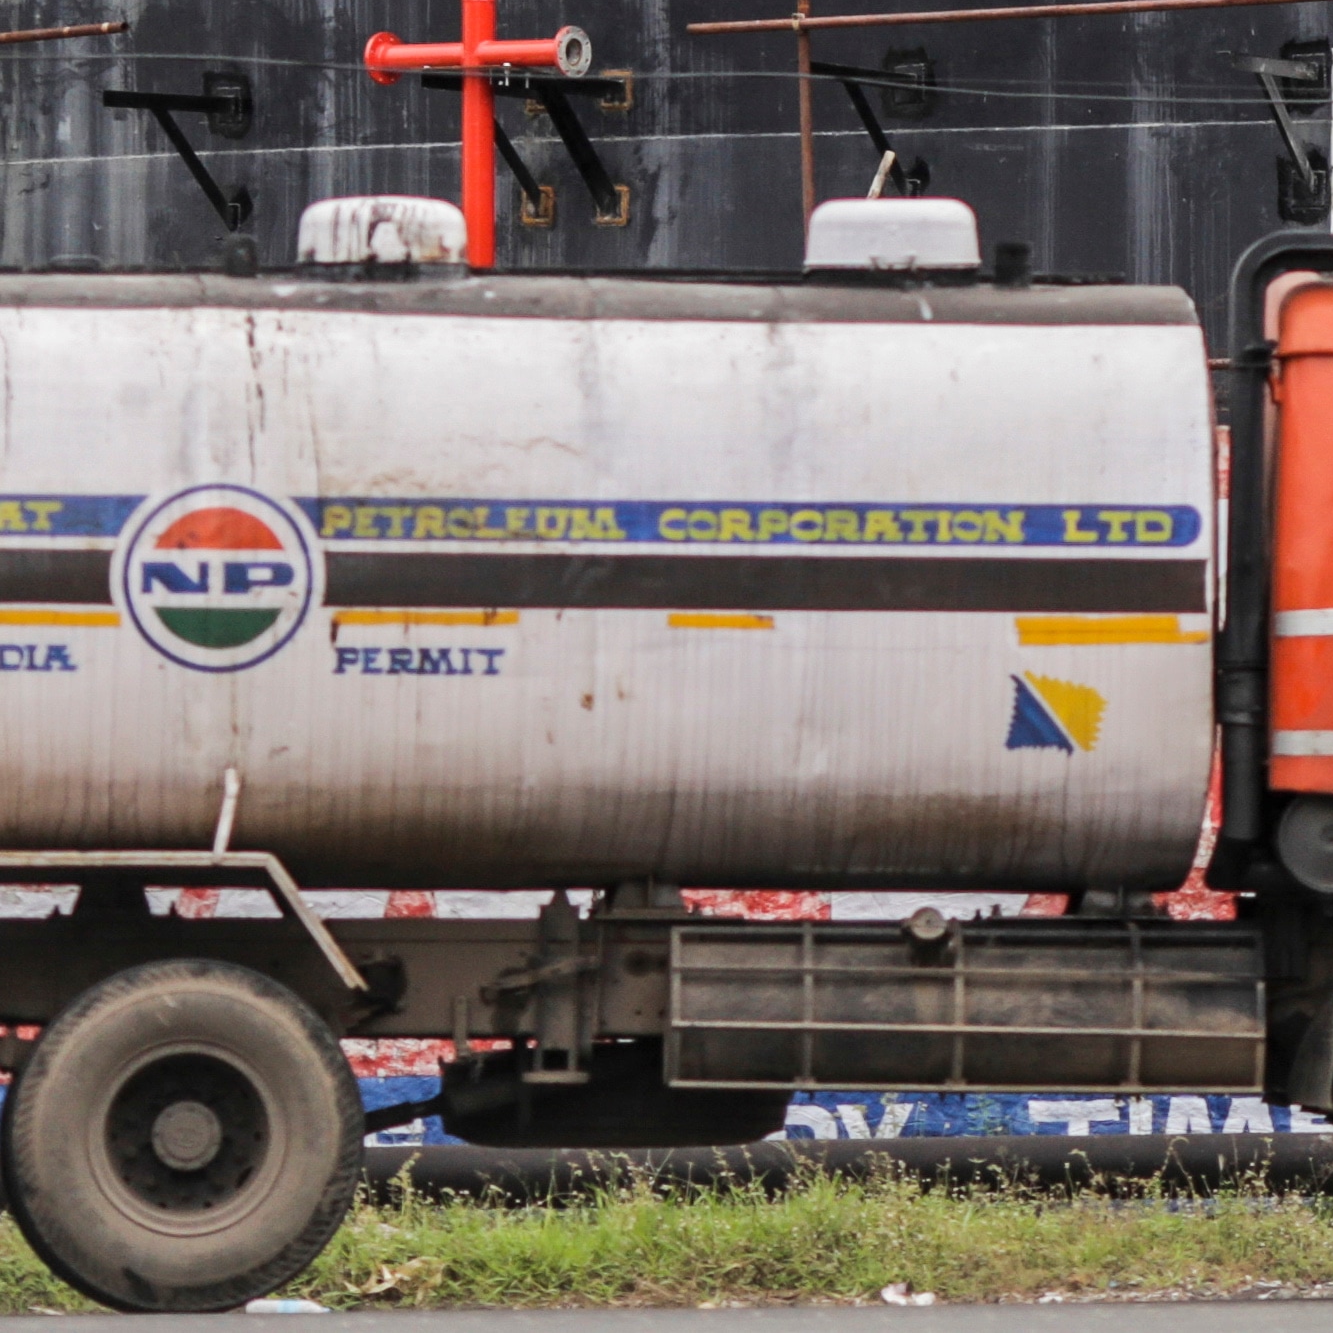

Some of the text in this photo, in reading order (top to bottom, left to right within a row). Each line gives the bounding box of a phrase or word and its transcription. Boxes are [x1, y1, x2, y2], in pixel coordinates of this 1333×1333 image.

[319, 505, 627, 540] PETROLEUM
[658, 509, 1025, 543] CORPORATION
[1062, 510, 1174, 543] LTD
[141, 561, 295, 595] NP
[333, 646, 505, 675] PERMIT
